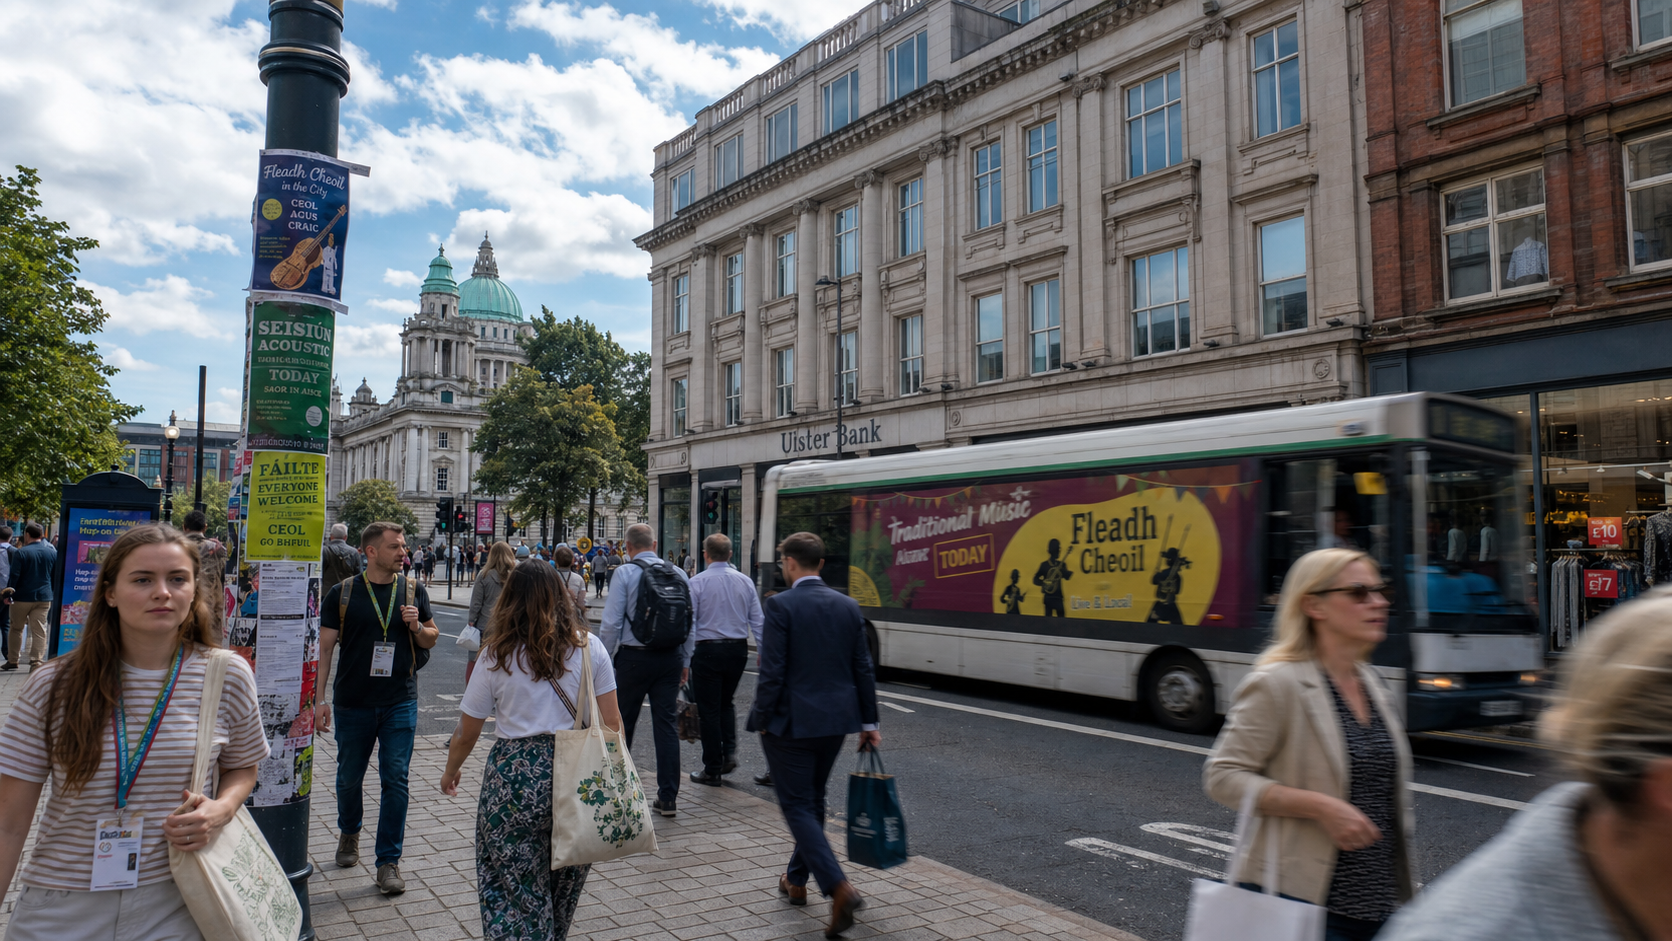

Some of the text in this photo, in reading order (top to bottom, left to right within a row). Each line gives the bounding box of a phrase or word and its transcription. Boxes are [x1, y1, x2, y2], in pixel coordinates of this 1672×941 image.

[264, 164, 345, 190] Fleadh Cheoil
[282, 181, 328, 199] in the City
[291, 199, 318, 210] CEOL
[288, 222, 319, 232] CRAIC
[258, 320, 331, 342] SEISIÚN
[258, 340, 330, 357] ACOUSTIC
[269, 369, 320, 384] TODAY
[836, 418, 882, 447] Bank
[259, 459, 319, 476] FÁILTE
[258, 482, 318, 493] EVERYONE
[258, 495, 318, 506] WELCOME
[268, 524, 305, 535] CEOL
[888, 500, 1031, 545] Traditional Music
[1071, 506, 1158, 545] Fleadh
[1593, 524, 1617, 538] £10
[277, 538, 311, 547] BHFUIL
[939, 544, 988, 569] TODAY
[1080, 545, 1145, 574] Cheoil
